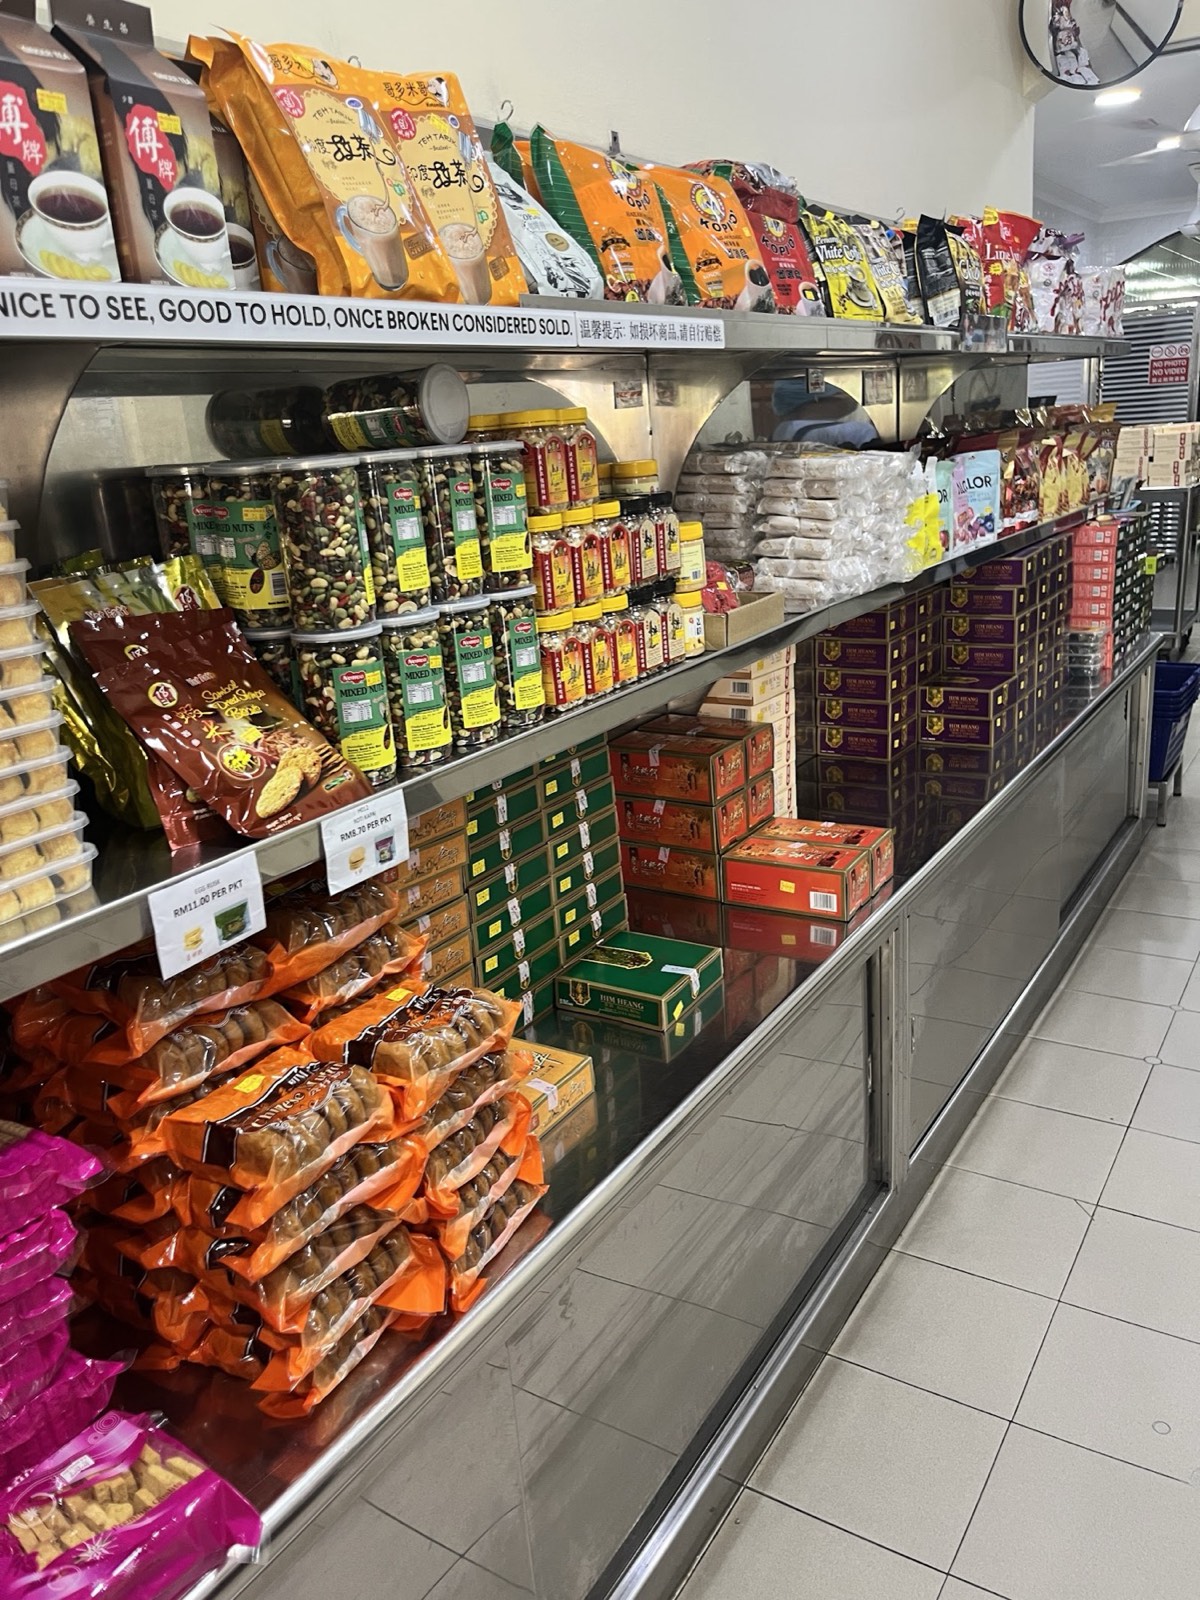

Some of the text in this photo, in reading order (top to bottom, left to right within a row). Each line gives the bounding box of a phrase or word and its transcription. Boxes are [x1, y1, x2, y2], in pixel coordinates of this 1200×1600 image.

[0, 291, 573, 336] NICE TO SEE, GOOD TO HOLD, ONCE BROKEN CONSIDERED SOLD.
[1164, 360, 1187, 368] PHOTO
[1164, 368, 1186, 376] VIDEO
[394, 504, 415, 515] MIXED
[514, 636, 534, 646] MIXED
[460, 650, 483, 661] MIXED
[405, 669, 430, 680] MIXED
[340, 688, 368, 698] MIXED
[367, 819, 380, 831] PER
[380, 814, 392, 825] PKT
[173, 879, 243, 918] RM11.00 PER PKT
[600, 994, 645, 1010] HIM HEANG
[252, 1091, 306, 1128] Chinese
